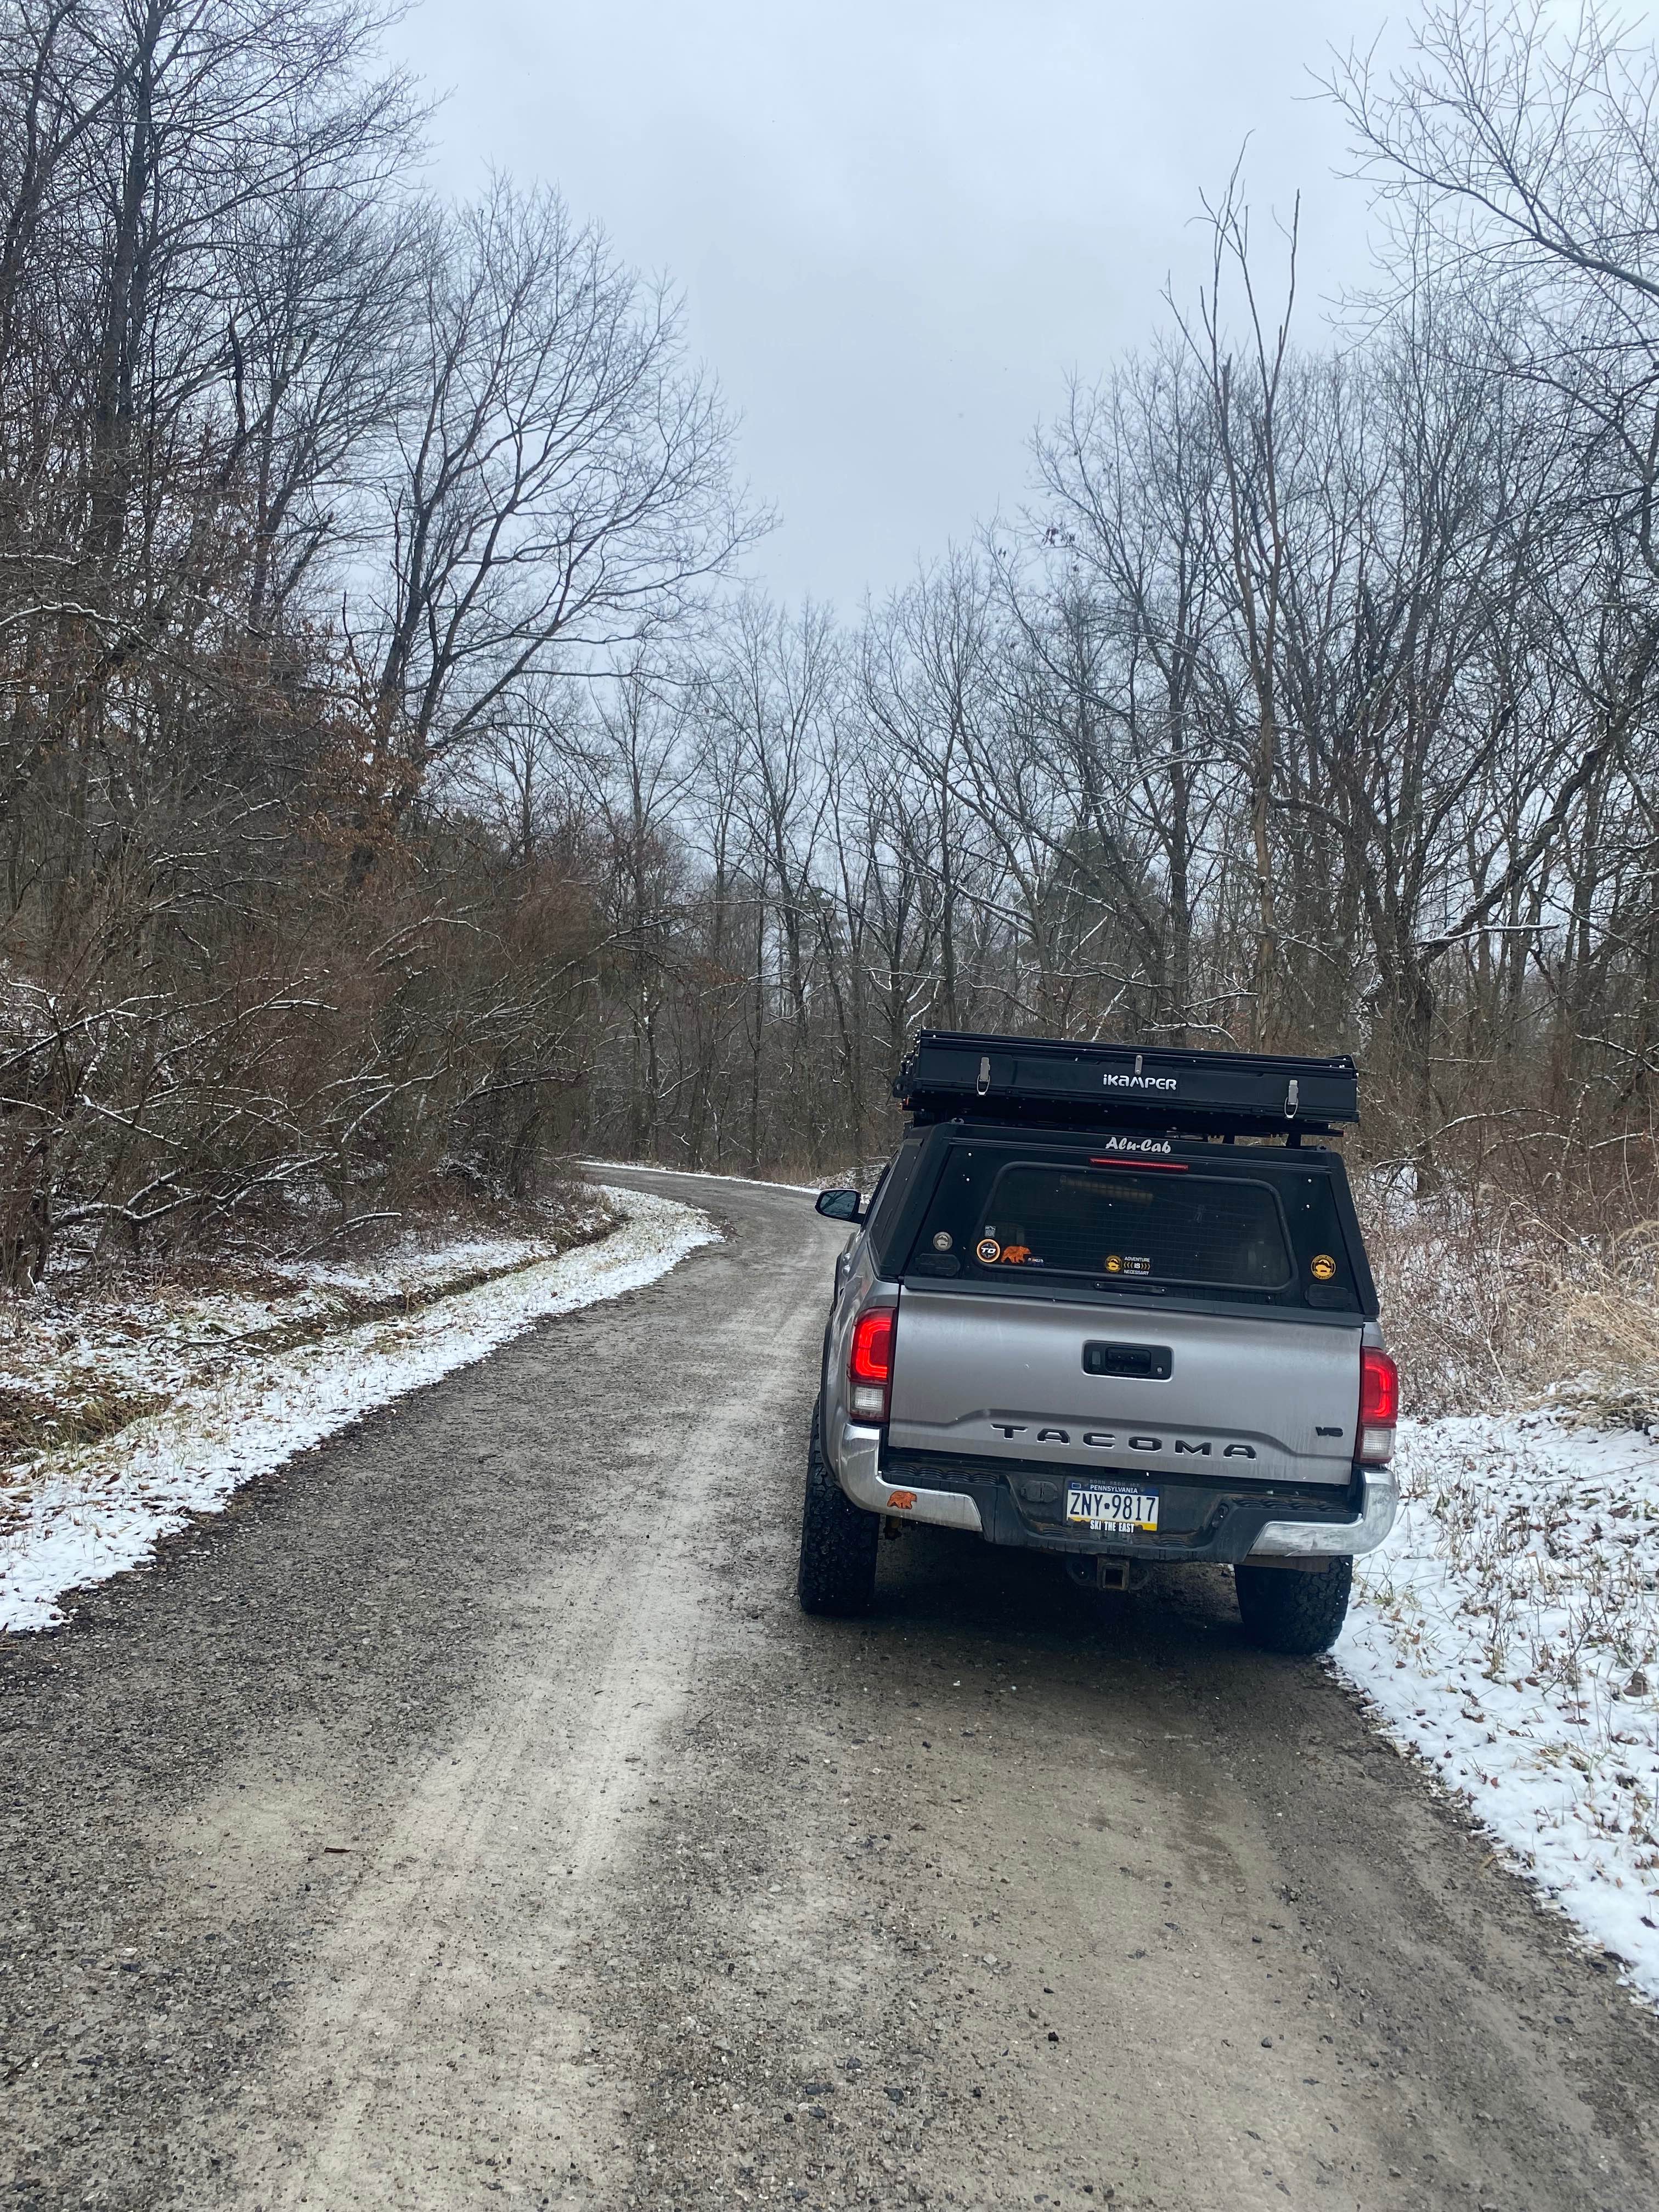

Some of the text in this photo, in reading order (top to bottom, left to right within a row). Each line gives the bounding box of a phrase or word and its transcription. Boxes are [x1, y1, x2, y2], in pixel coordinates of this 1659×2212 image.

[1105, 1137, 1171, 1154] Alu-Cab
[990, 1423, 1257, 1460] TACOMA
[1090, 1485, 1138, 1494] PENNSYLVANIA
[1090, 1520, 1135, 1533] SKI THE EAST
